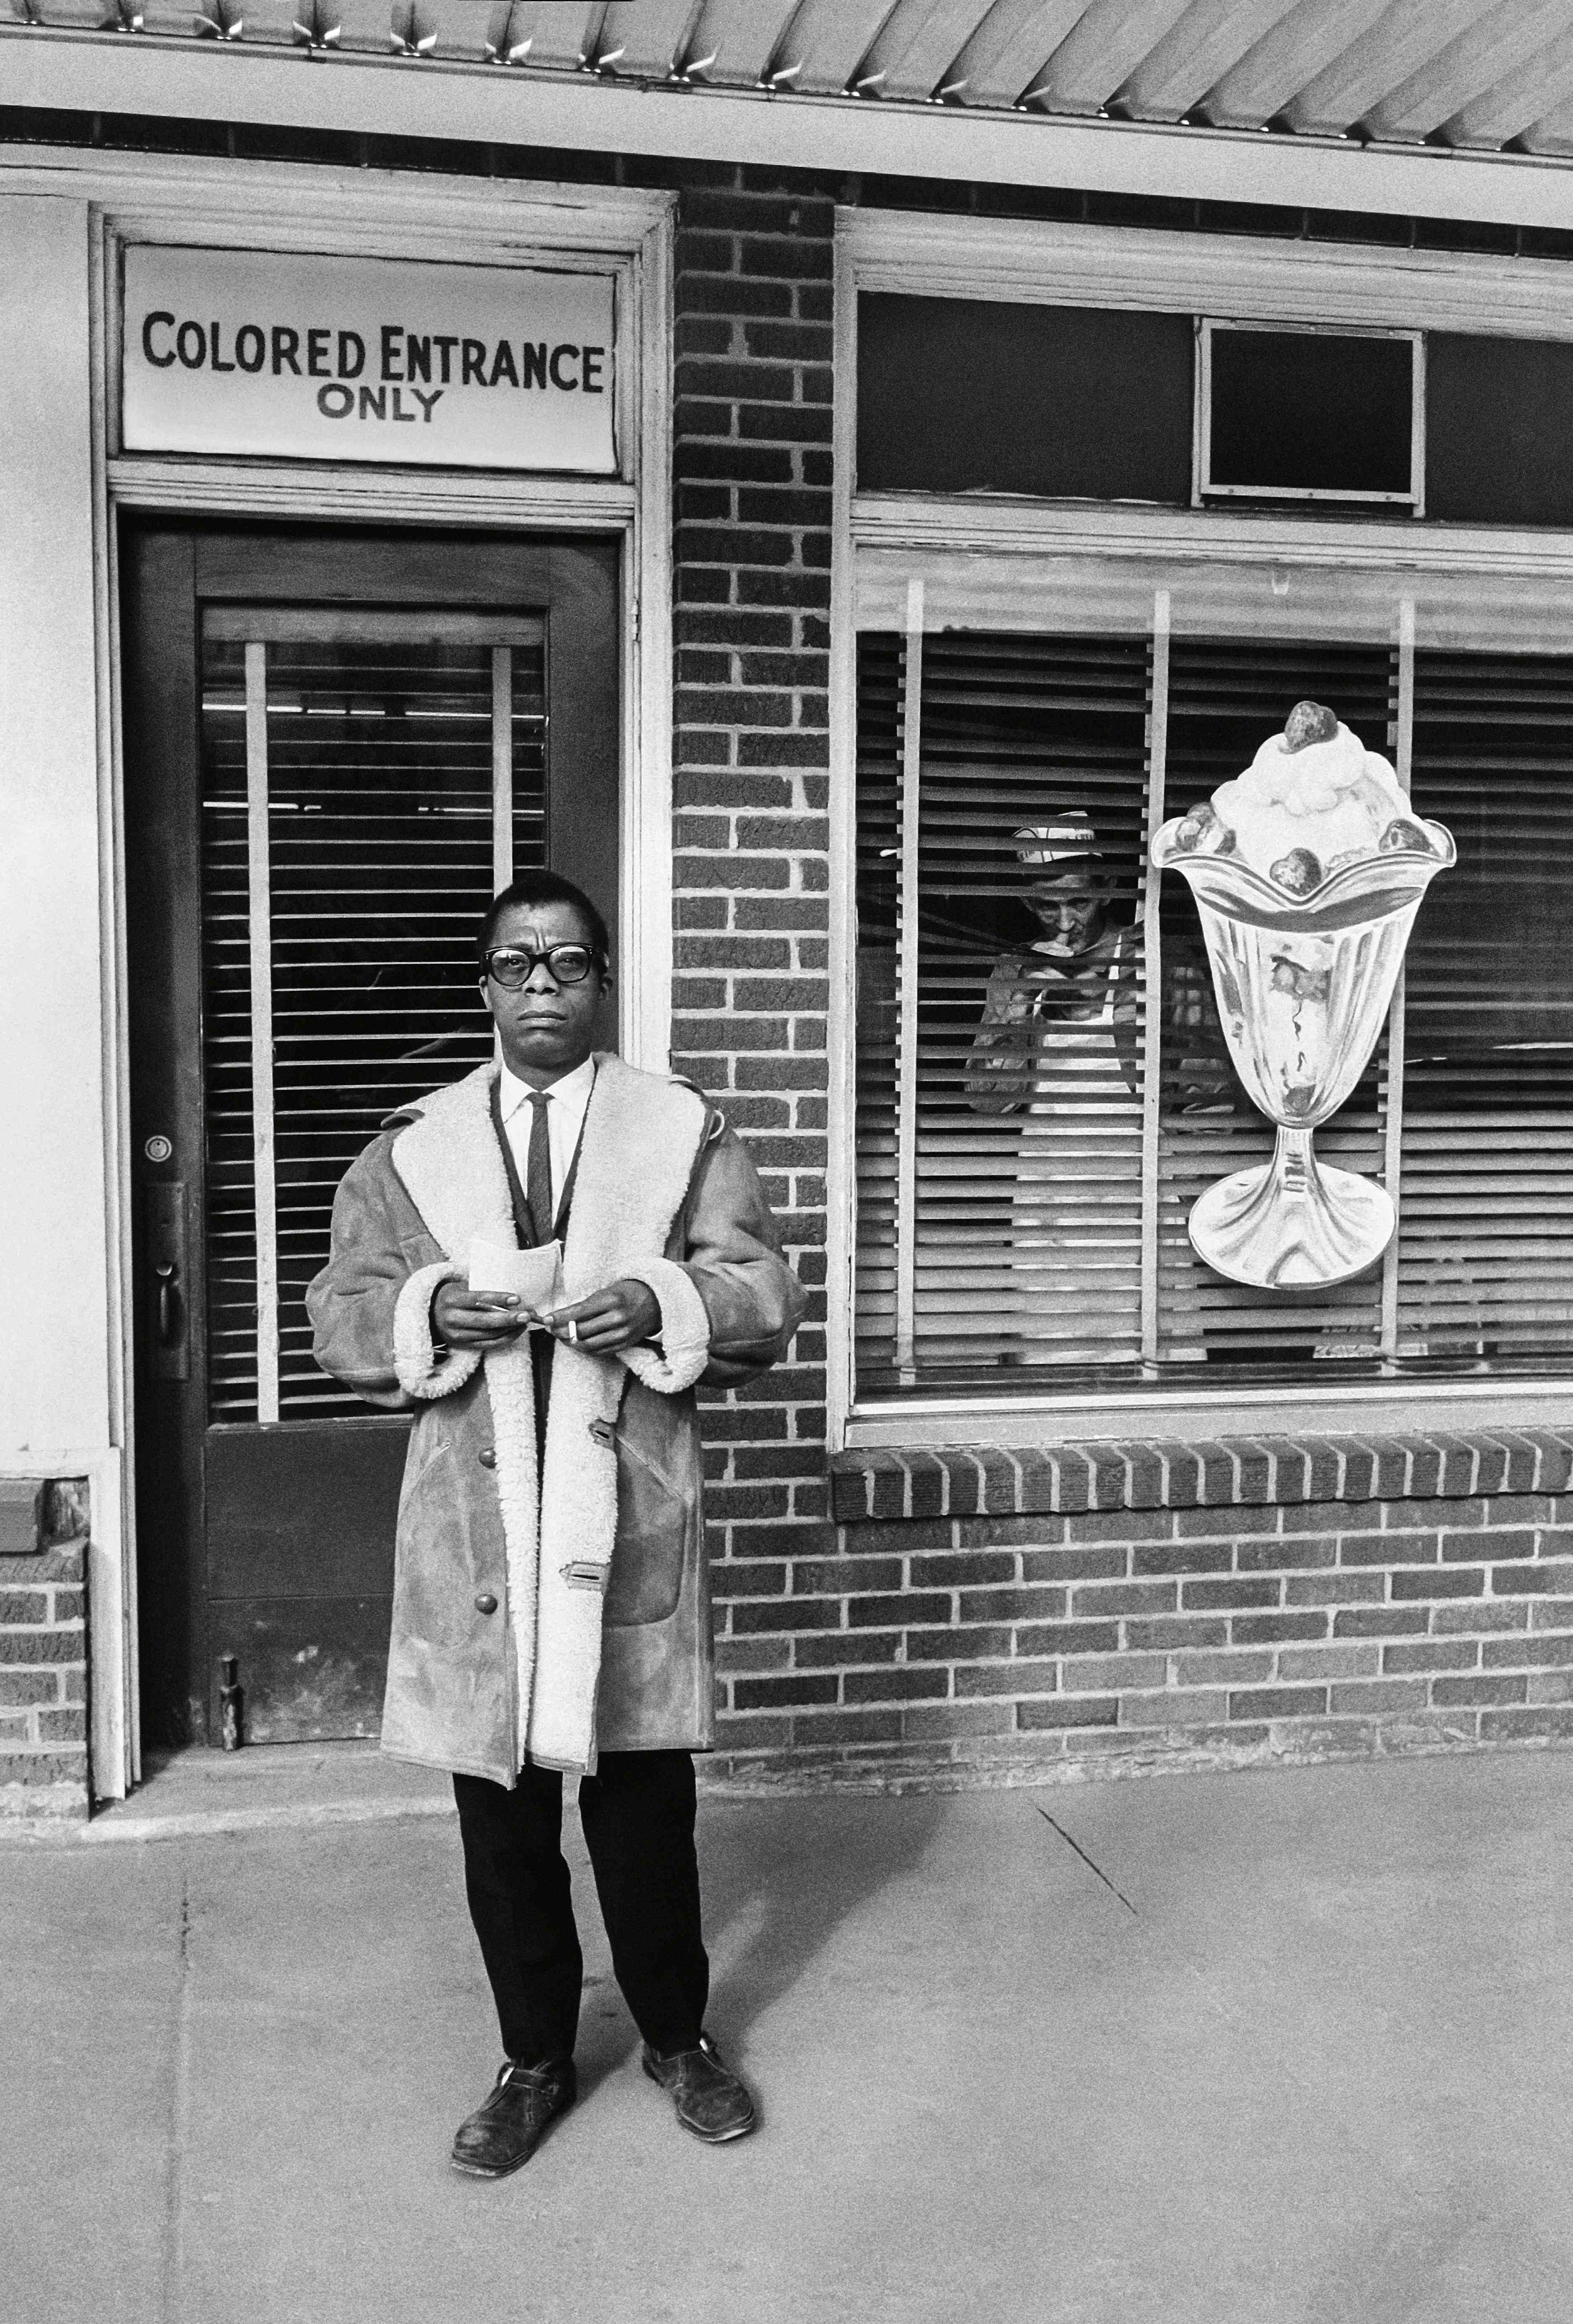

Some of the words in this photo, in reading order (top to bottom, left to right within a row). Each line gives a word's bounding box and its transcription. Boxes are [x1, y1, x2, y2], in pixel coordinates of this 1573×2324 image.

[142, 310, 366, 381] COLORED
[380, 325, 606, 393] ENTRANCE
[317, 383, 444, 422] ONLY
